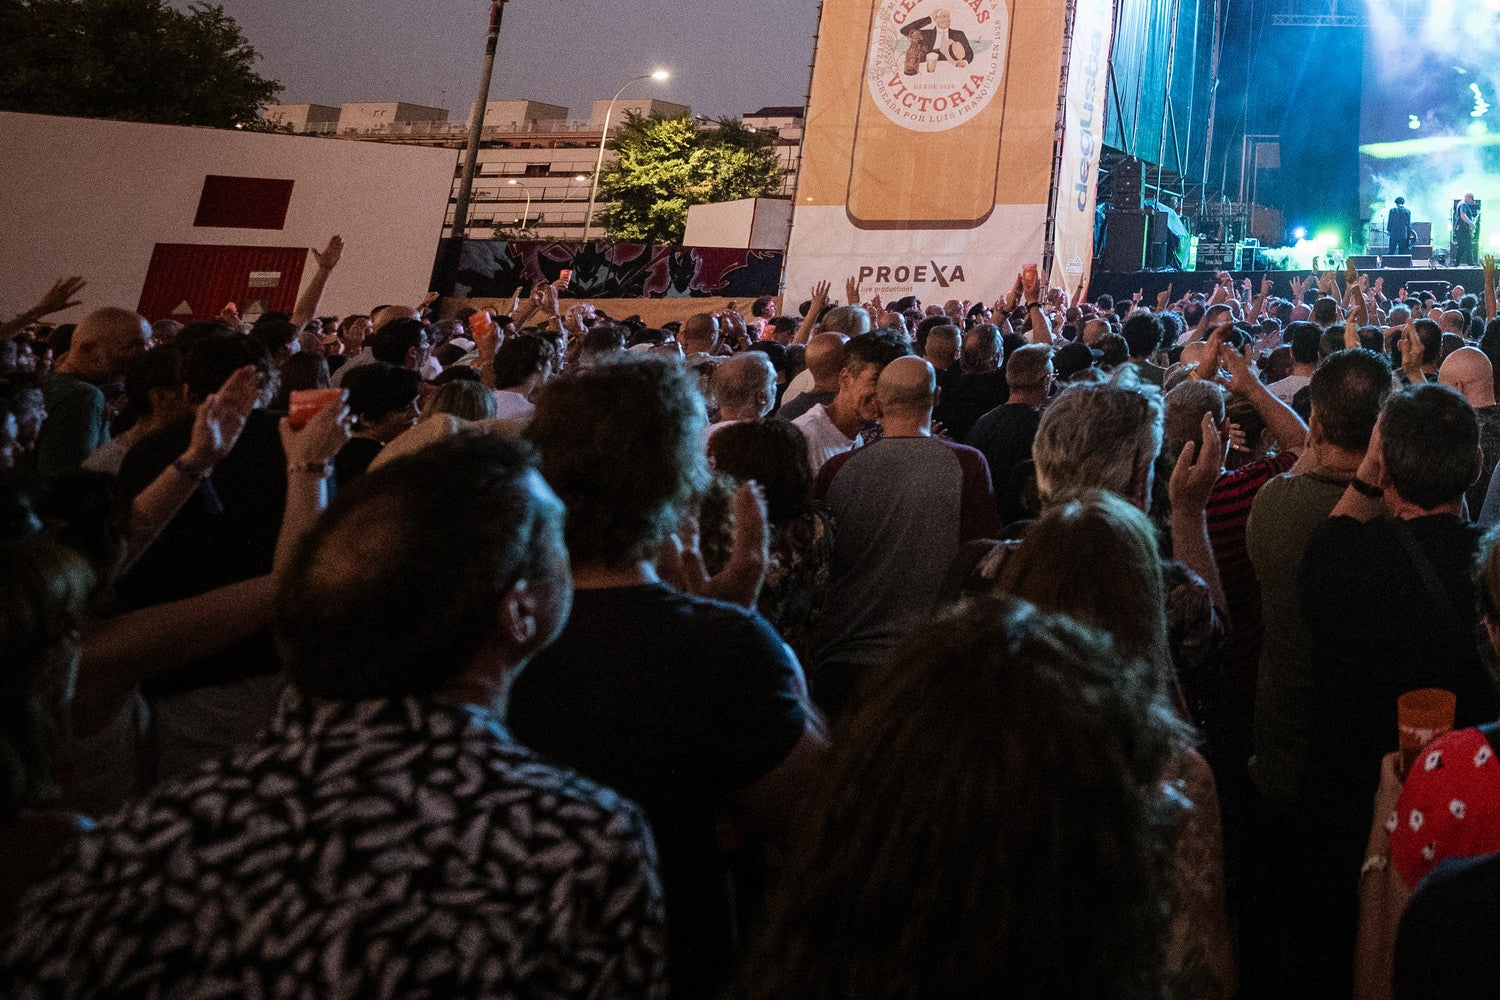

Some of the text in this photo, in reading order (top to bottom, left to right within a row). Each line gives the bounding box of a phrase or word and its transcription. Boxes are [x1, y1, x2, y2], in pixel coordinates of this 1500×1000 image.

[877, 80, 902, 115] CREADA
[902, 111, 926, 123] POR
[929, 112, 956, 123] LUIS
[958, 62, 998, 116] FRANQUELO
[991, 43, 1000, 61] EN
[887, 72, 985, 113] VICTORIA
[1074, 31, 1102, 213] degusta
[859, 260, 966, 287] PROEXA
[874, 285, 913, 293] productions
